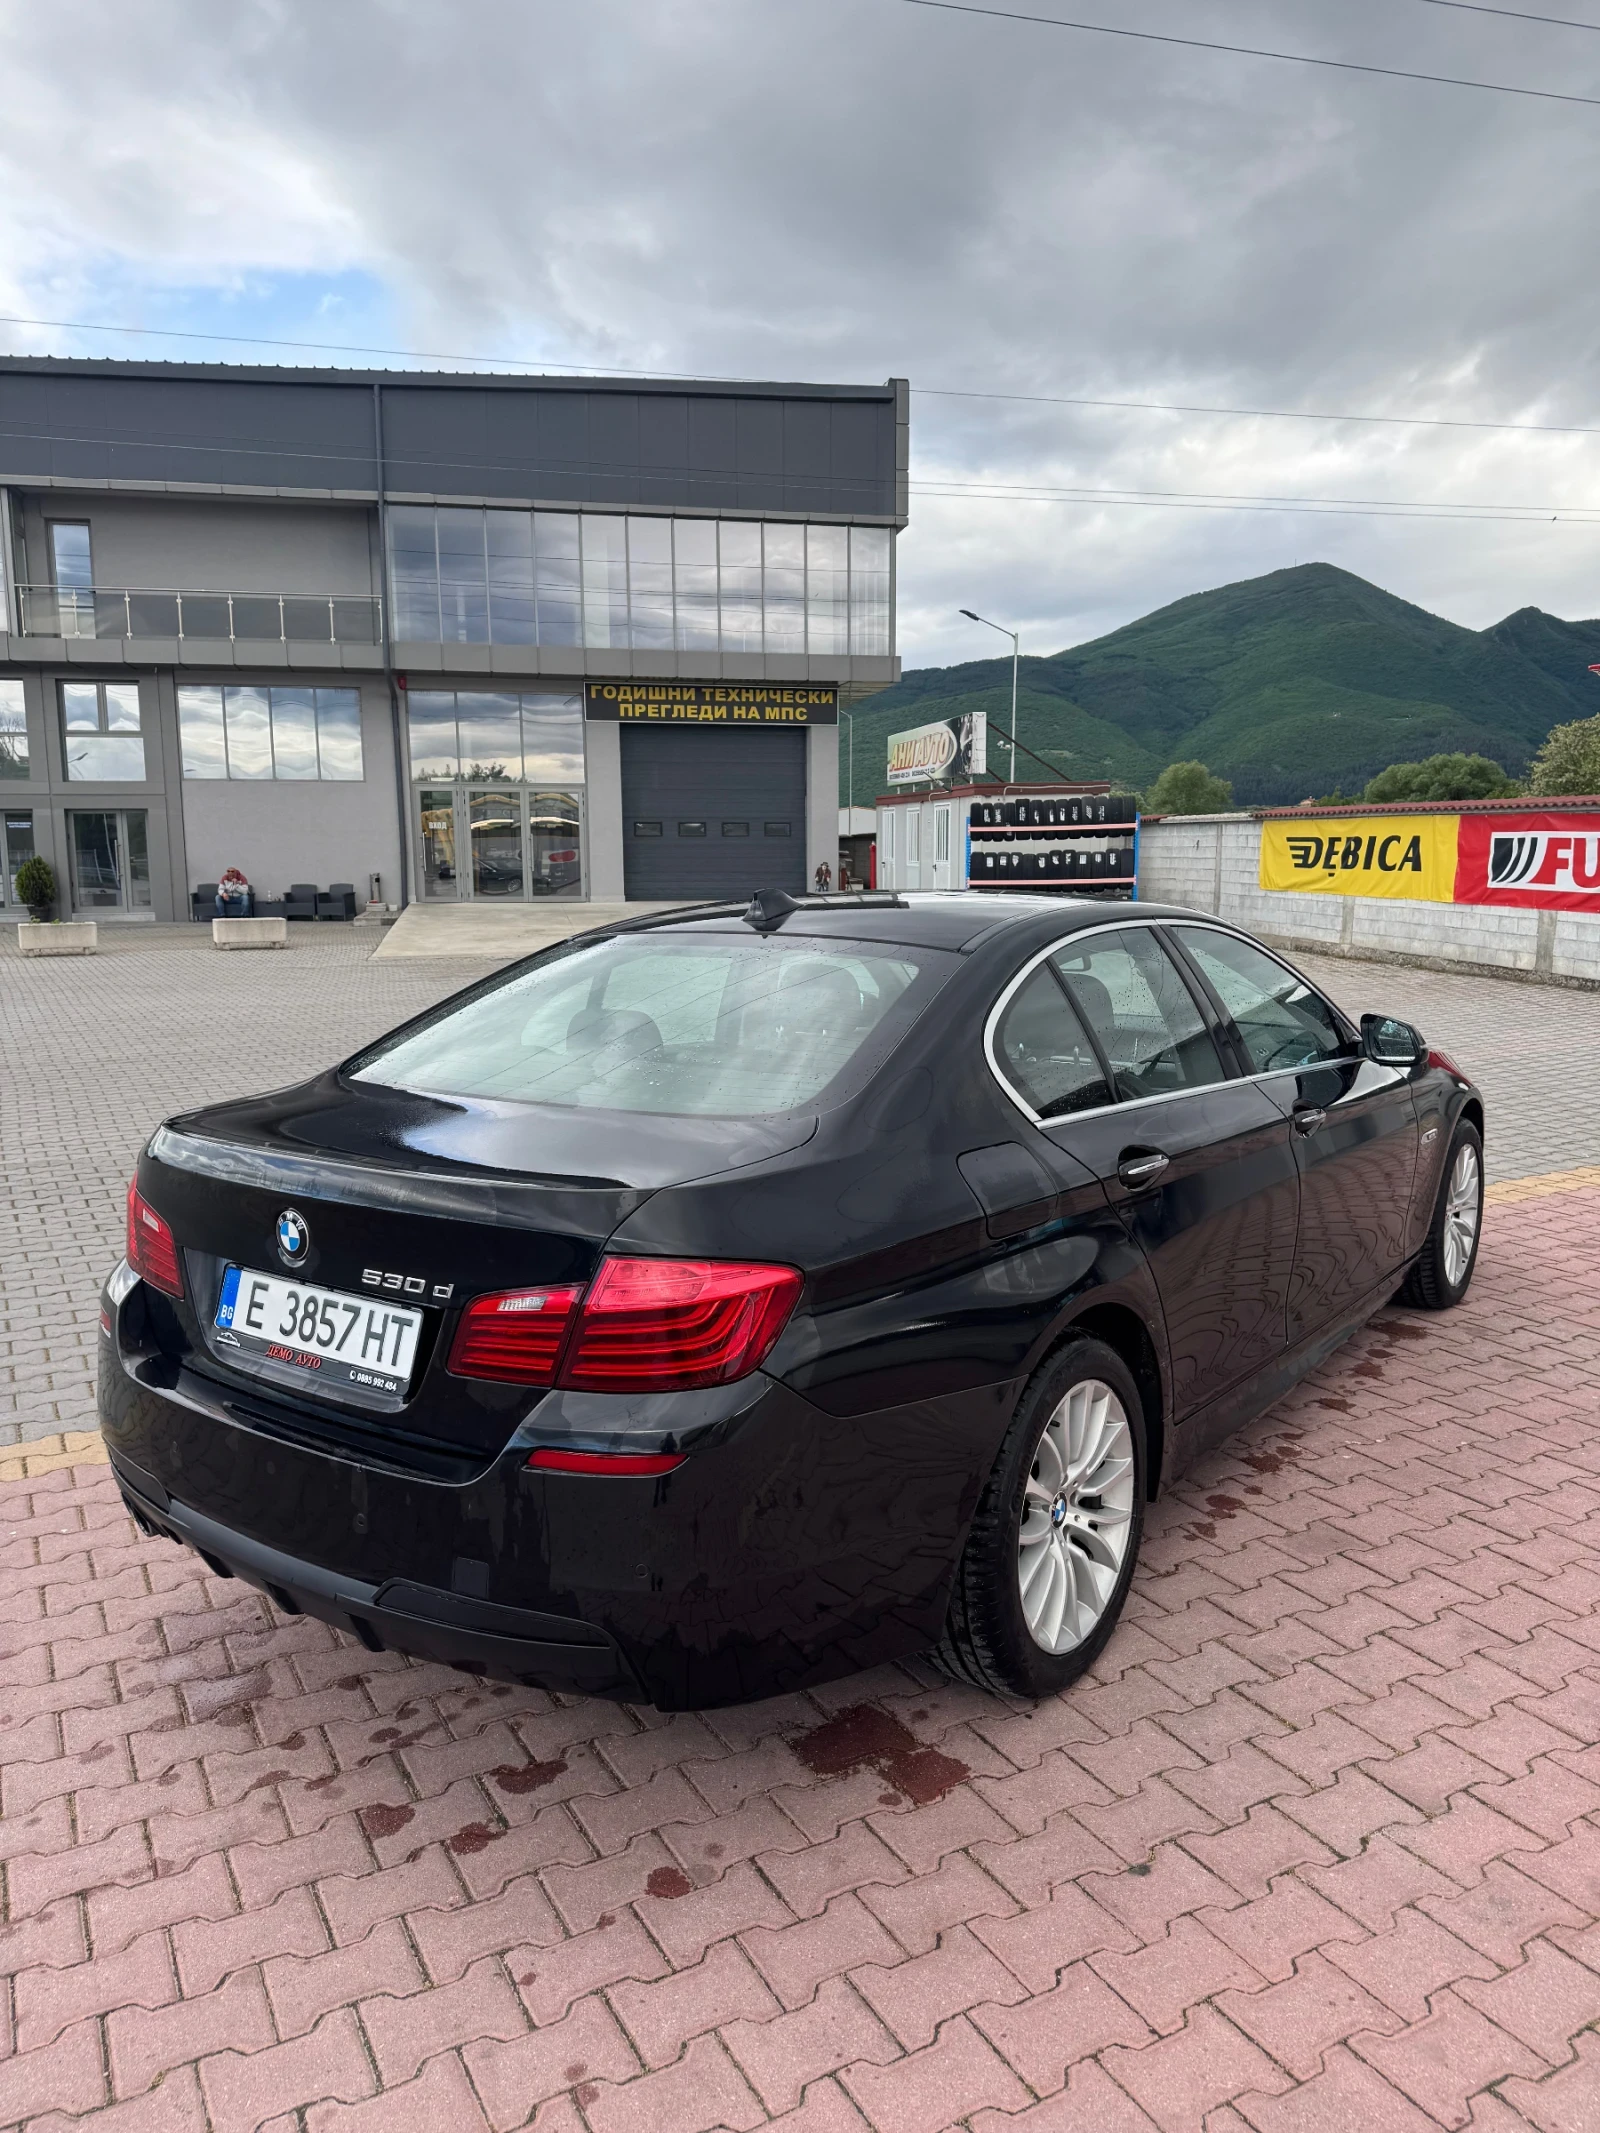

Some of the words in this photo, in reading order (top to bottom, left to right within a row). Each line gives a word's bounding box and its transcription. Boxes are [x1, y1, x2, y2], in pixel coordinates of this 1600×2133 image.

[590, 685, 696, 702] ГОДИШНИ
[702, 687, 834, 705] ТЕХНИЧЕСКИ
[619, 704, 727, 721] ПРЕГЛЕДИ
[733, 705, 760, 720] НА
[765, 707, 808, 721] МПС
[889, 740, 917, 772] АНИ
[361, 1268, 426, 1295] 530
[432, 1283, 455, 1299] d
[220, 1304, 234, 1320] BG
[265, 1345, 293, 1361] ДЕМО
[295, 1354, 322, 1369] АУТО
